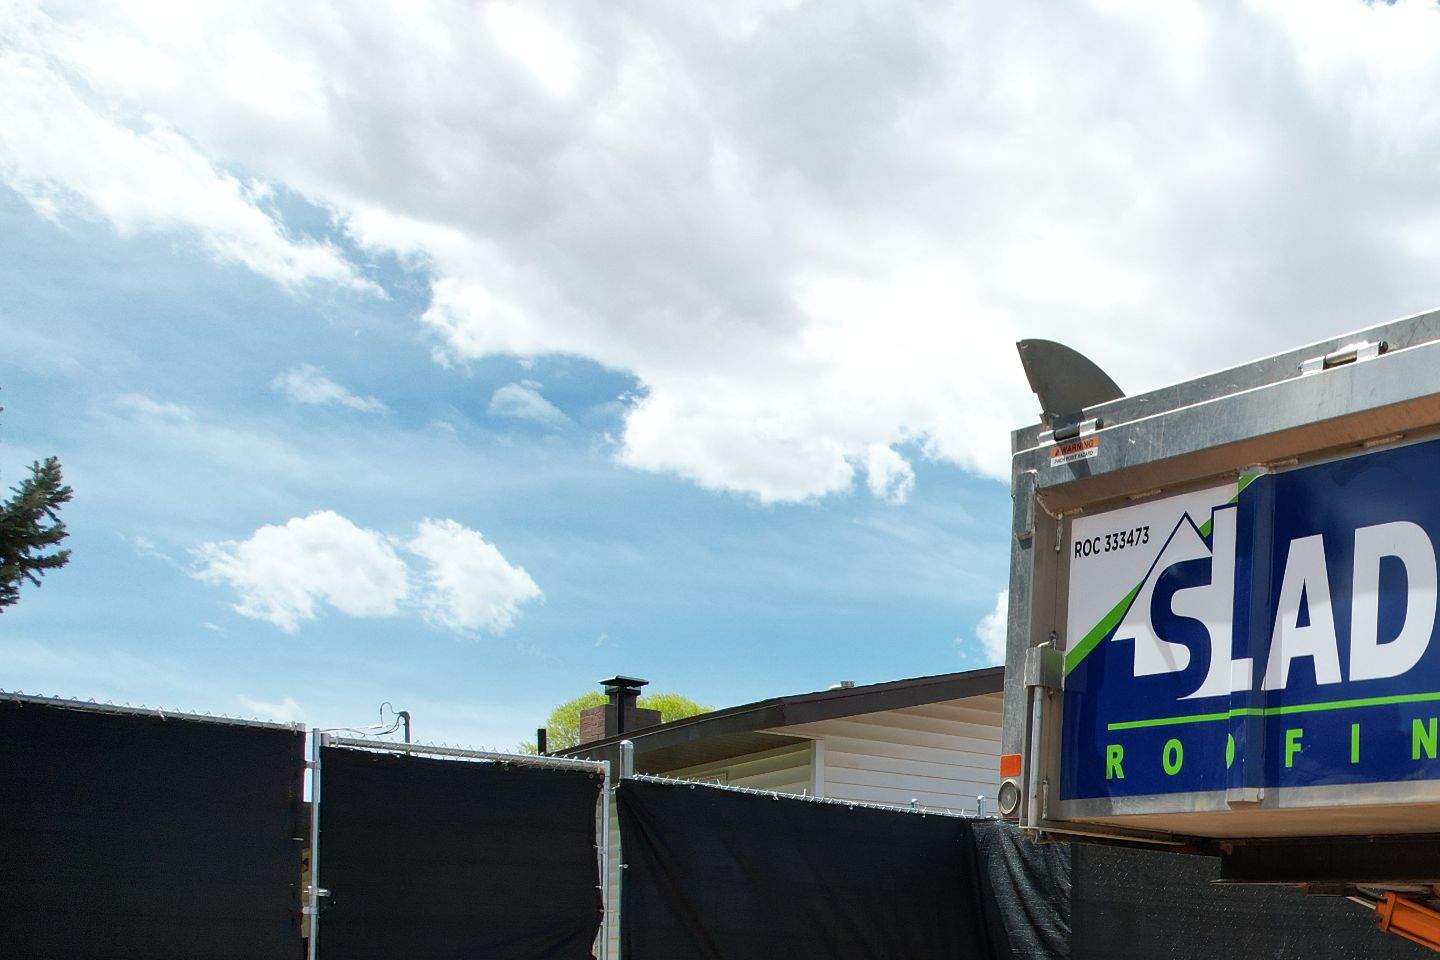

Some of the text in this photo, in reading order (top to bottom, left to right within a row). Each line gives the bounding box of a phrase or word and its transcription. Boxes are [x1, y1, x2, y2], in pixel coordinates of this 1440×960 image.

[1061, 439, 1094, 455] WARNING
[1074, 526, 1150, 559] ROC 333473
